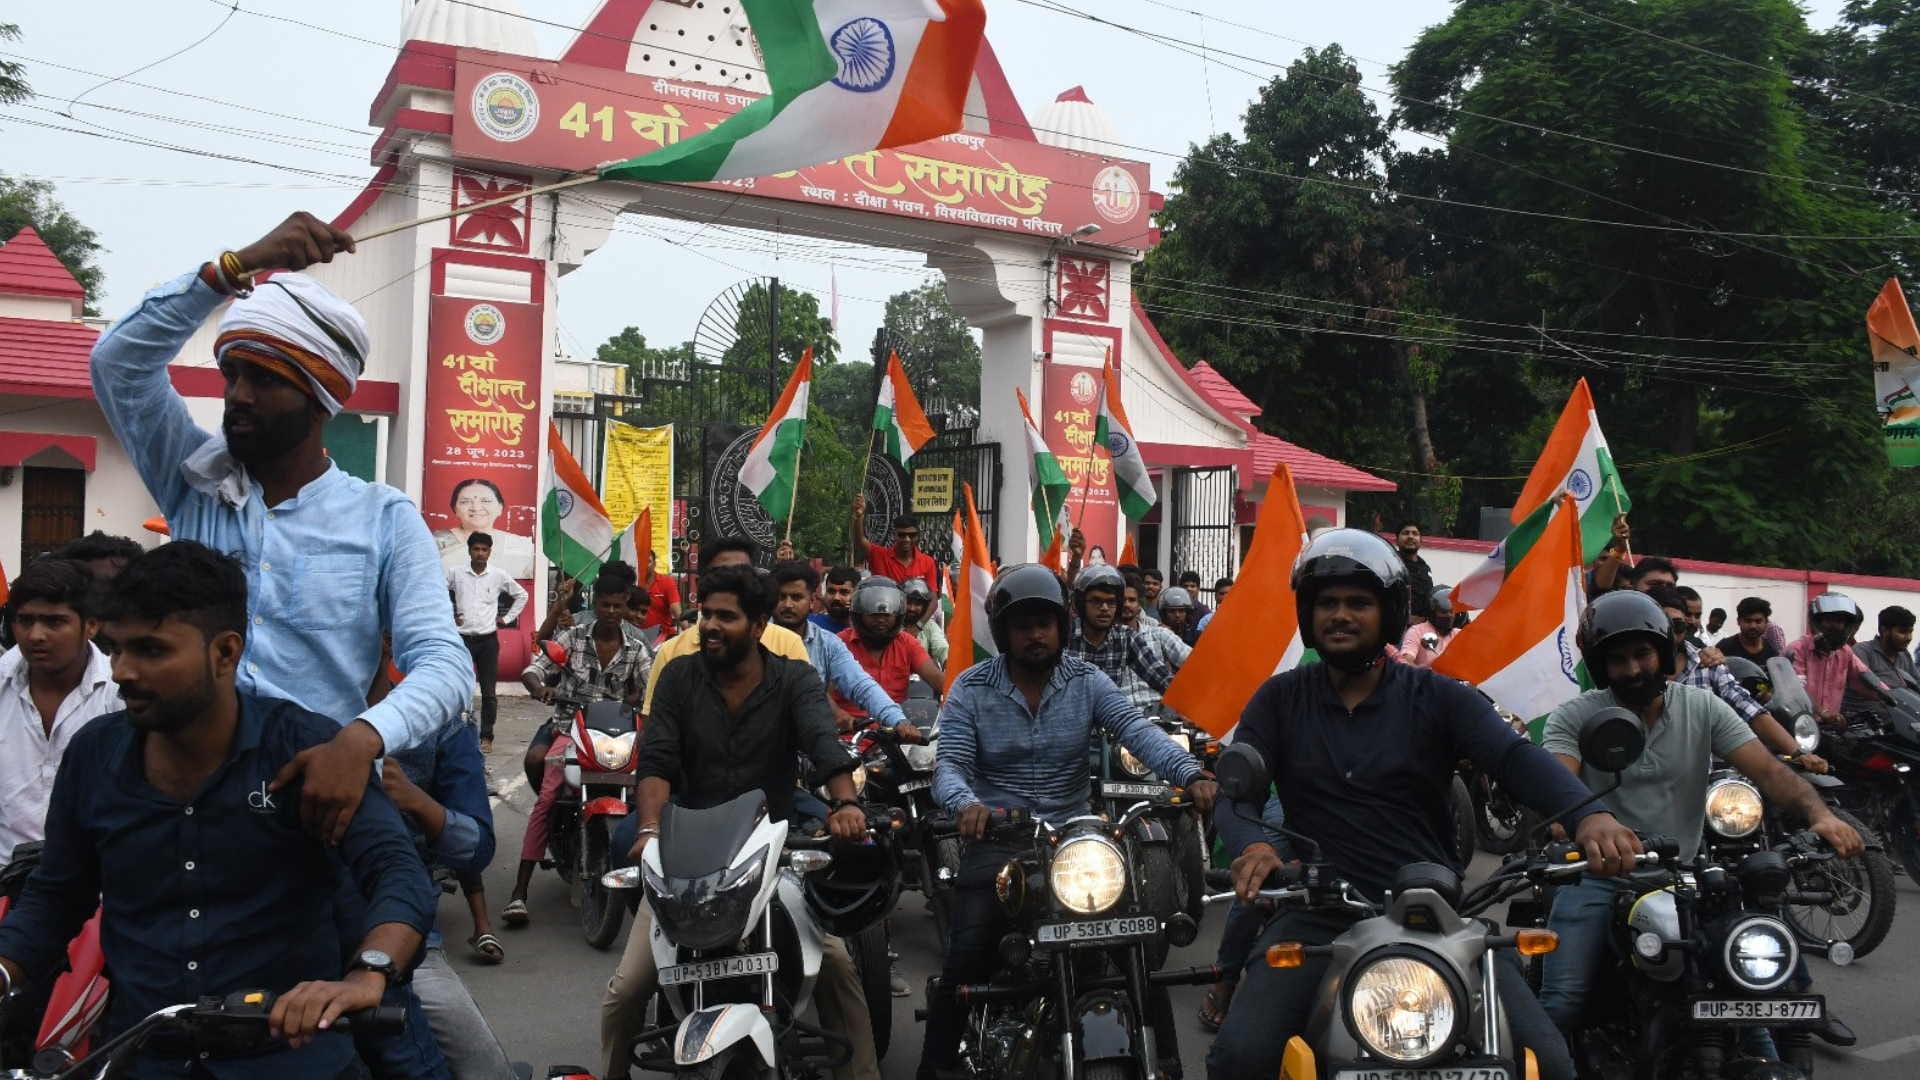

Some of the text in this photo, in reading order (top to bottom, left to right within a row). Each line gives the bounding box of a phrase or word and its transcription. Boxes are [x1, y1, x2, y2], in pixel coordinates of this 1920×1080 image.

[560, 102, 614, 142] 41
[942, 133, 985, 150] रखपुर
[800, 185, 835, 201] स्थल
[853, 190, 887, 208] दीक्षा
[442, 353, 466, 370] 41
[446, 447, 461, 456] 28
[494, 449, 525, 458] 2023
[1054, 918, 1155, 939] UP 53EK 6088
